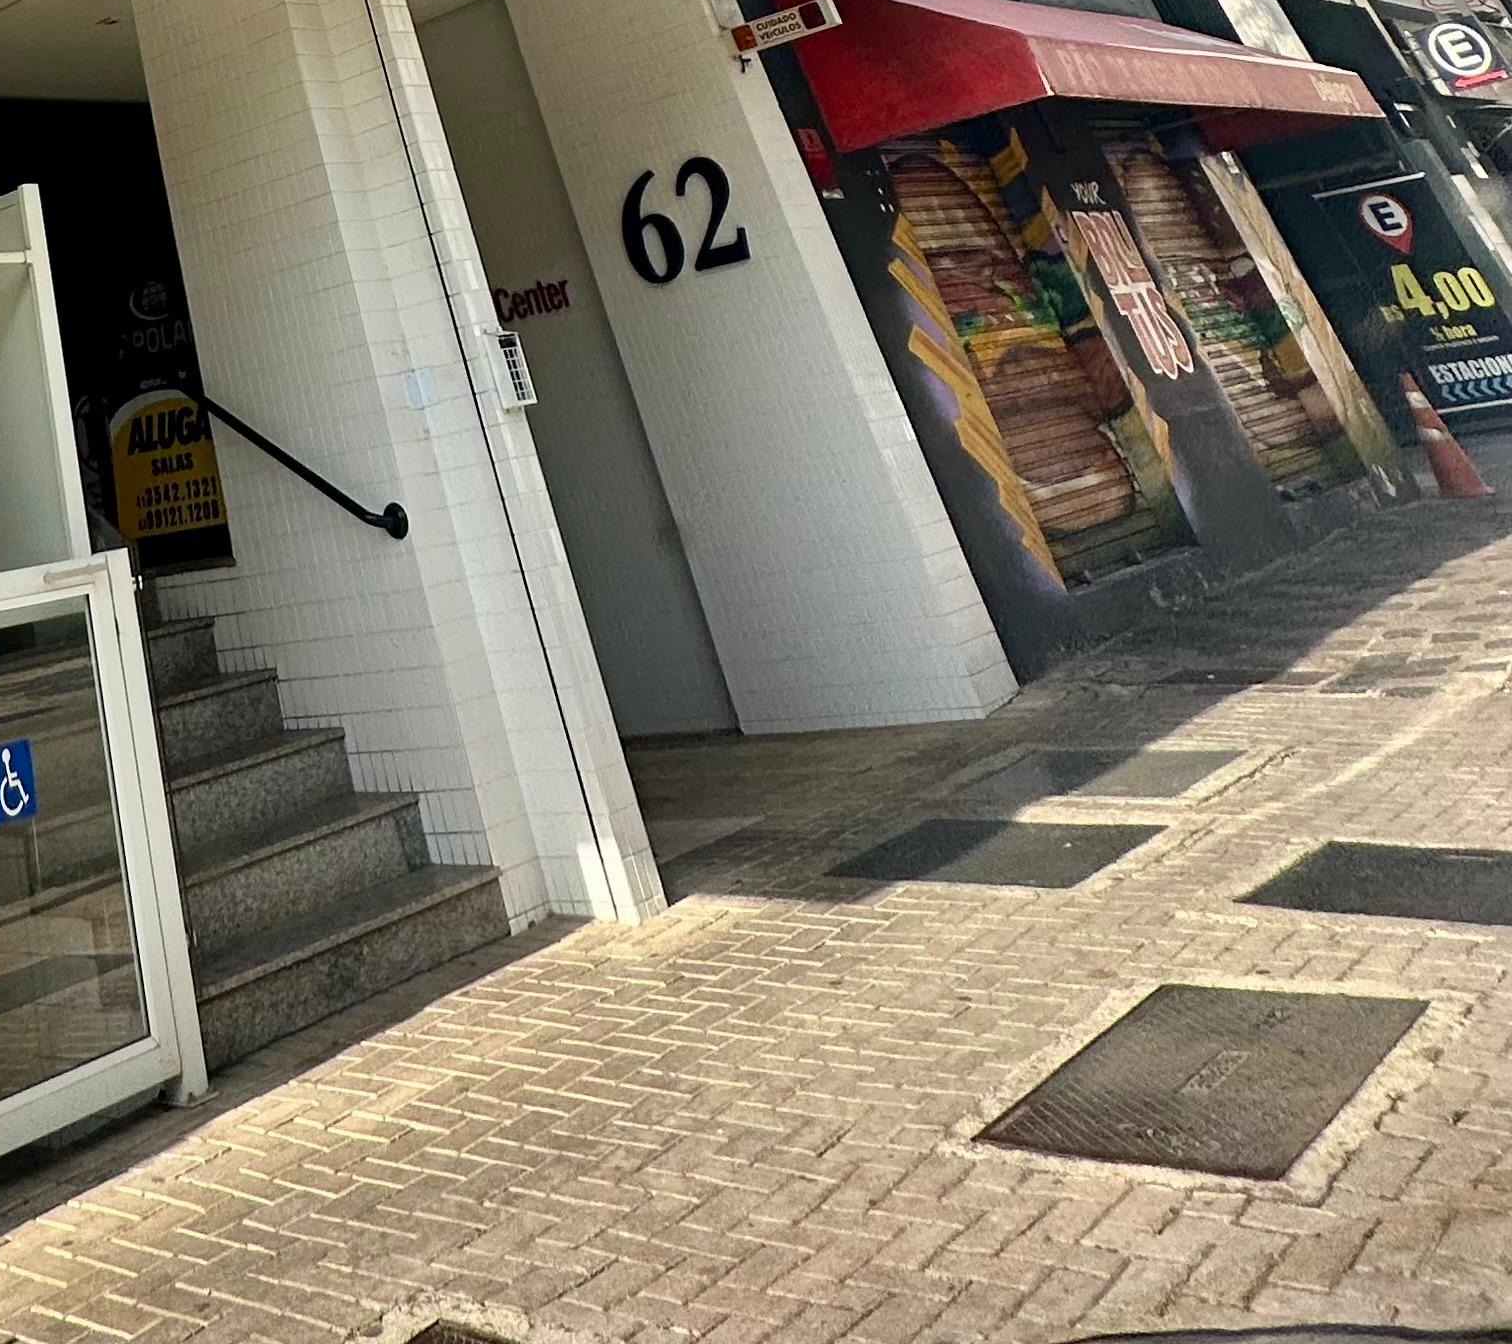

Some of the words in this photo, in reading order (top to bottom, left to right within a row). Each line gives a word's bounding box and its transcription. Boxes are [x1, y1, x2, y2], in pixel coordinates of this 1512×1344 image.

[755, 11, 797, 31] CUIDADO
[1437, 29, 1483, 69] E
[1070, 180, 1108, 206] YOUR
[622, 156, 751, 284] 62
[1369, 201, 1404, 232] E
[493, 279, 571, 324] Center
[1390, 262, 1496, 320] 4,00
[1441, 323, 1478, 340] hora
[1428, 352, 1512, 385] ESTACION
[127, 406, 213, 456] ALUGA
[151, 452, 194, 476] SALAS
